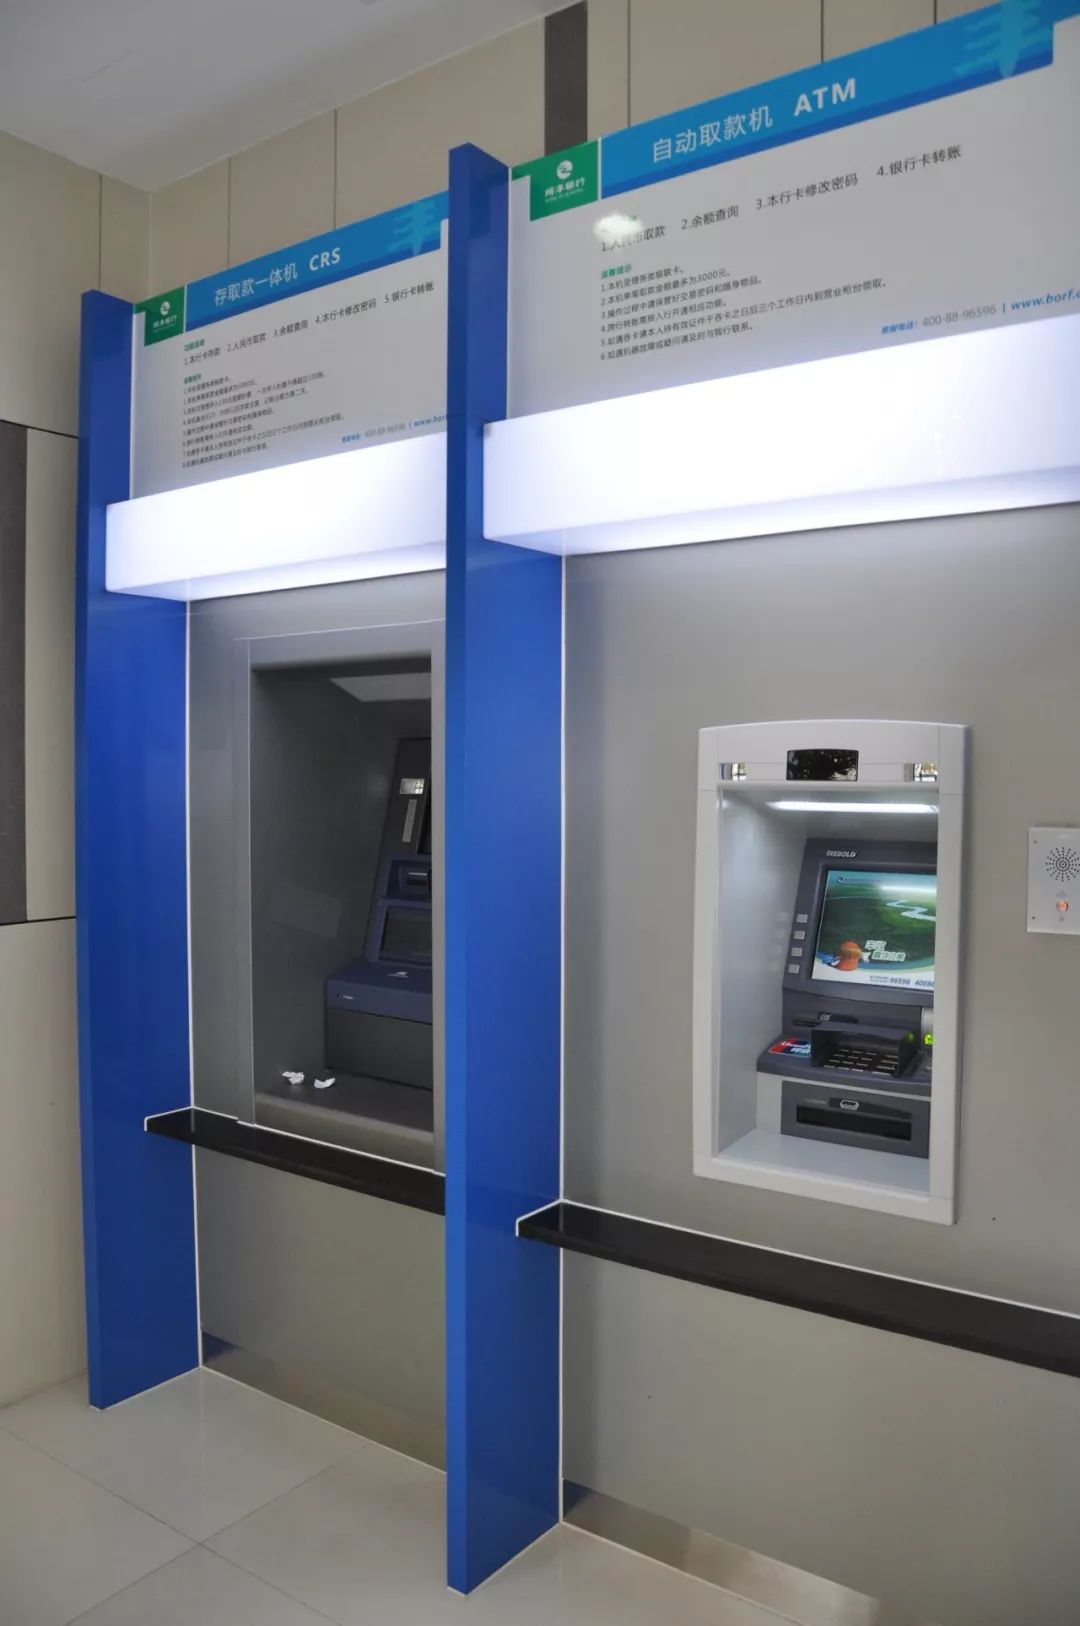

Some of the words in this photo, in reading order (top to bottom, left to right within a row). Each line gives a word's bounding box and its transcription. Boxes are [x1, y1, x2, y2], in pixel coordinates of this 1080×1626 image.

[652, 105, 773, 163] 自动取款机
[793, 77, 857, 118] ATM
[681, 205, 739, 230] 2.余额查询
[756, 172, 858, 210] 3.本行卡修改密码
[876, 144, 962, 178] 4.银行卡转账
[214, 264, 298, 306] 存取款一体机
[309, 247, 341, 272] CRS
[922, 303, 997, 327] 400-88-96596
